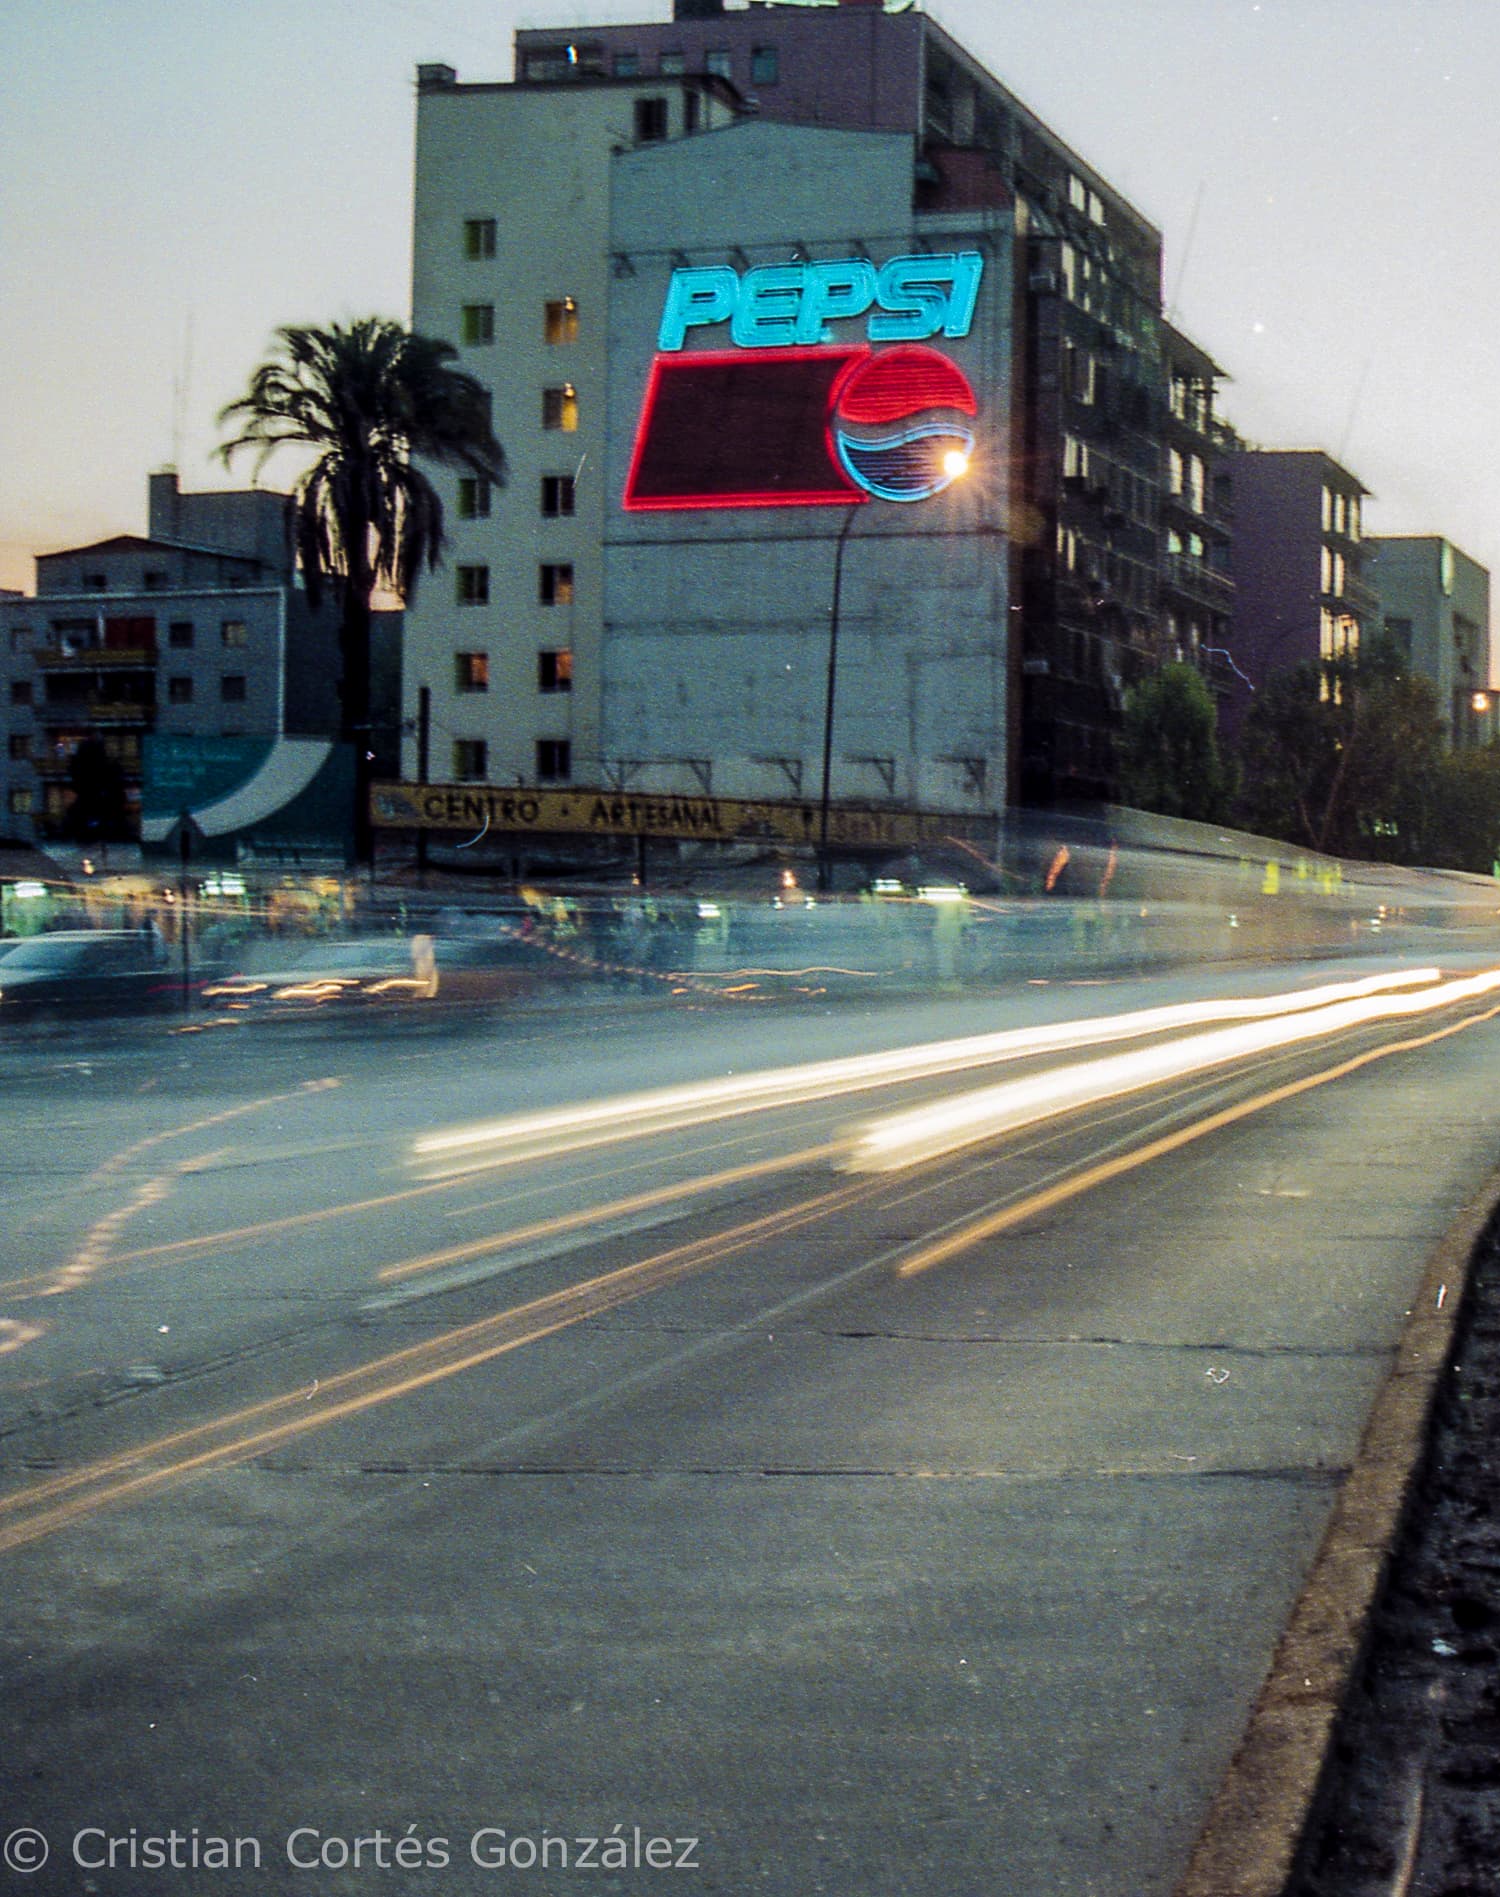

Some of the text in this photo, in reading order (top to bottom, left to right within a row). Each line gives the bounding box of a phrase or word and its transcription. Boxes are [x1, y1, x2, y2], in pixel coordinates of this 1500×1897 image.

[659, 251, 984, 352] PEPSI
[423, 795, 724, 832] CENTRO ARTESANAL
